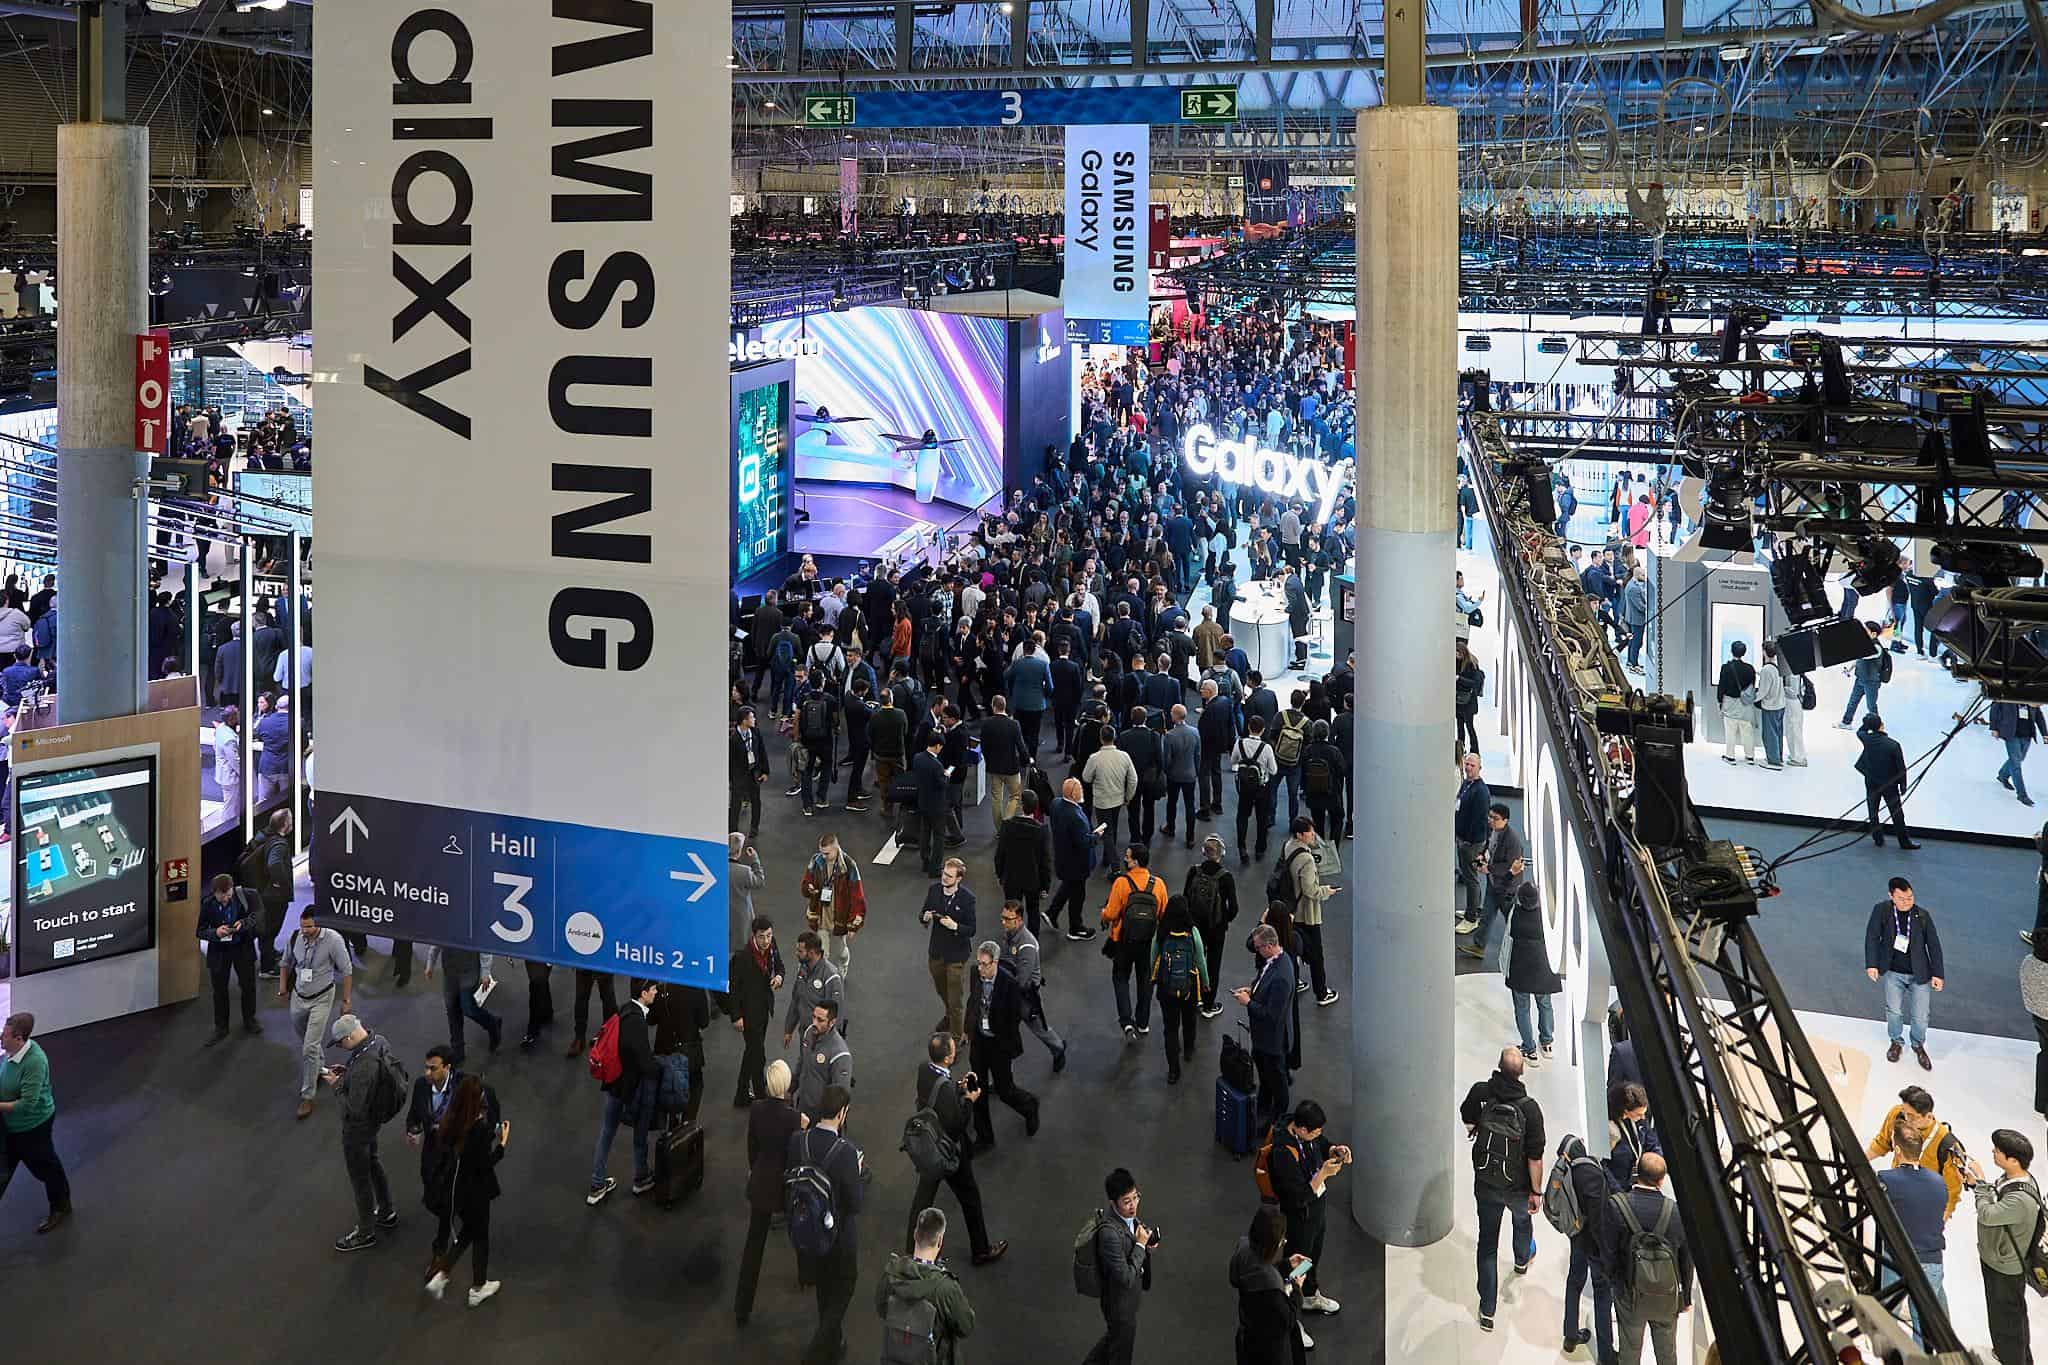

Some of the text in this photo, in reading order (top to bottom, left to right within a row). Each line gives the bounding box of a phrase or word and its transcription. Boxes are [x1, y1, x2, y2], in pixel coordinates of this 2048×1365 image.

[1001, 91, 1023, 125] 3
[1075, 150, 1102, 251] Galaxy
[364, 8, 493, 440] alaxy
[1113, 151, 1135, 292] SAMSUNG
[1101, 329, 1112, 342] 3
[1184, 422, 1347, 526] Galaxy
[35, 734, 72, 746] Microsoft
[490, 832, 536, 858] Hall
[330, 872, 449, 906] GSMA Media
[33, 901, 136, 931] Touch to start
[330, 897, 394, 923] Village
[489, 871, 534, 943] 3
[568, 927, 591, 938] Android
[615, 941, 665, 966] Halls
[671, 951, 684, 969] 2
[706, 955, 714, 974] 1
